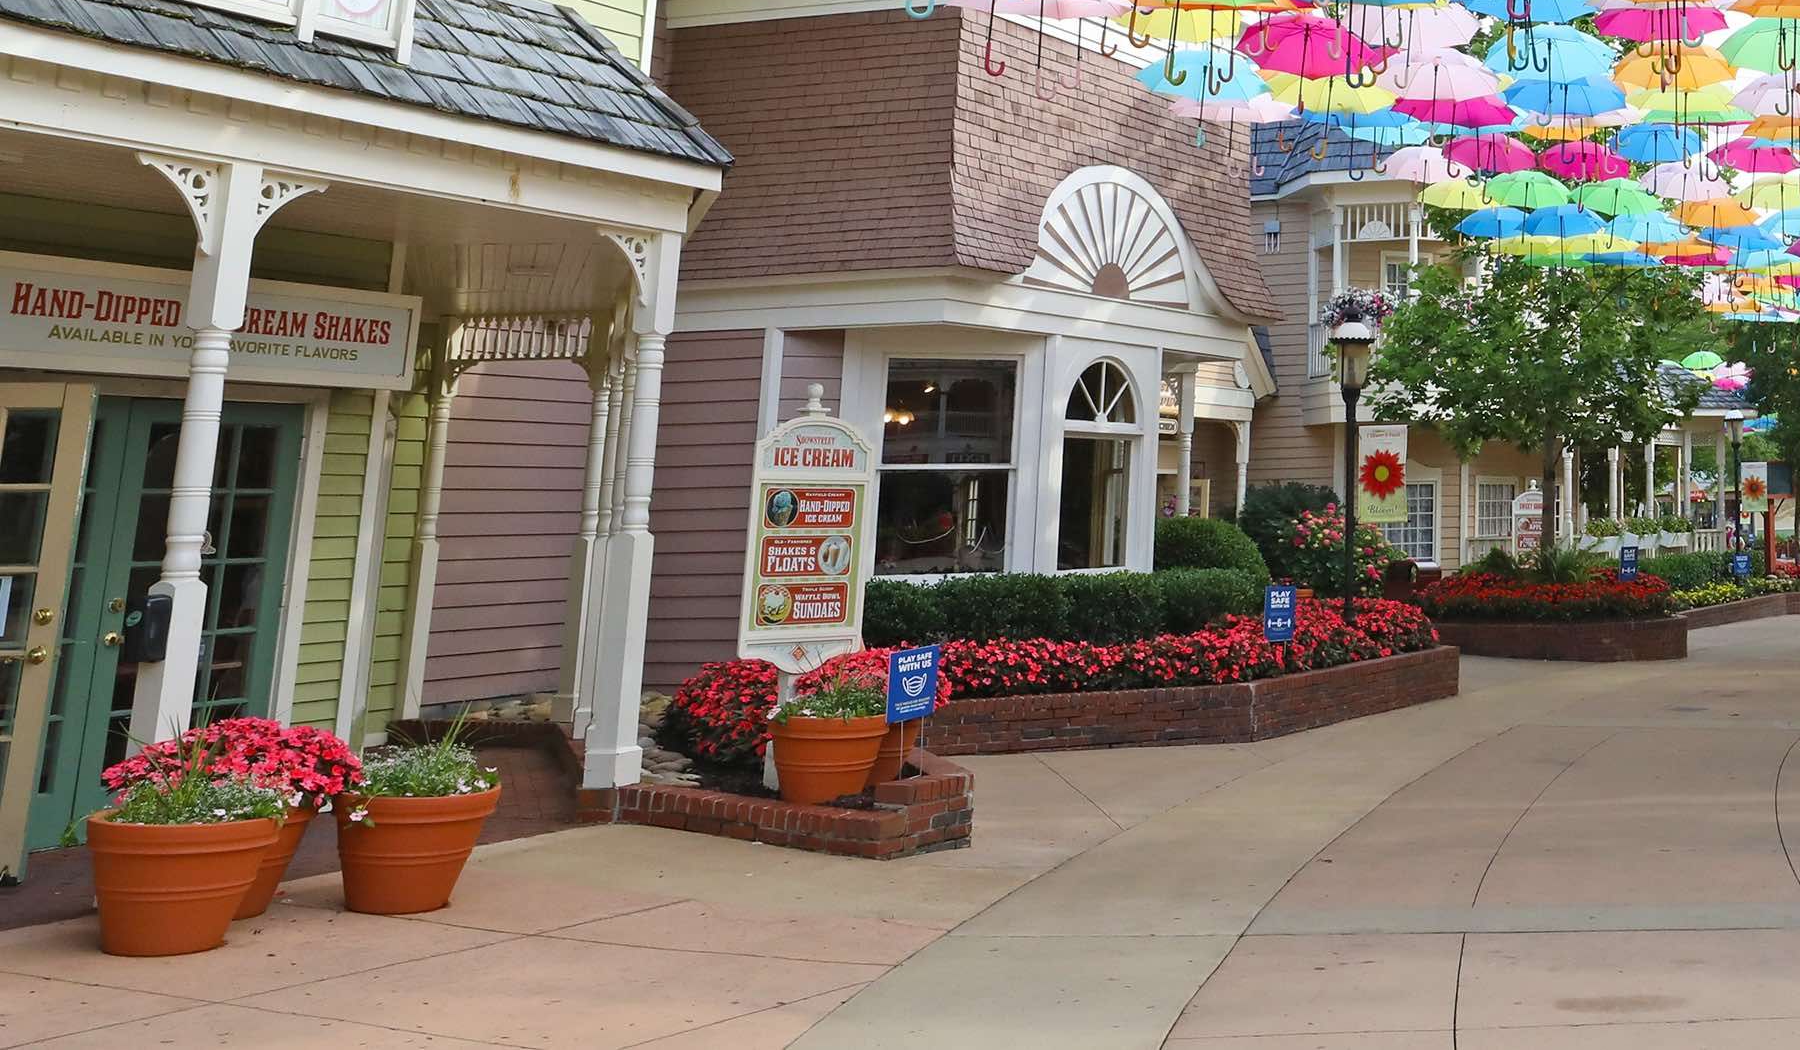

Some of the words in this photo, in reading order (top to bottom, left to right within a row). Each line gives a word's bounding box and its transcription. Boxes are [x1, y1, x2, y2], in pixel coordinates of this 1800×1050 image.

[10, 281, 182, 328] HAND-DIPPED
[313, 311, 392, 345] SHAKES
[48, 324, 144, 346] AVAILABLE
[149, 333, 165, 347] IN
[295, 345, 358, 361] FLAVORS
[774, 447, 799, 467] ICE
[802, 448, 855, 468] CREAM
[799, 500, 850, 513] HAND-DIPPED
[805, 514, 816, 523] ICE
[818, 514, 842, 523] CREAM
[768, 546, 806, 556] SHAKES
[767, 556, 815, 572] FLOATS
[793, 601, 841, 620] SUNDAES
[898, 655, 916, 664] PLAY
[917, 652, 932, 660] SAFE
[899, 661, 920, 672] WITH
[922, 659, 932, 669] US
